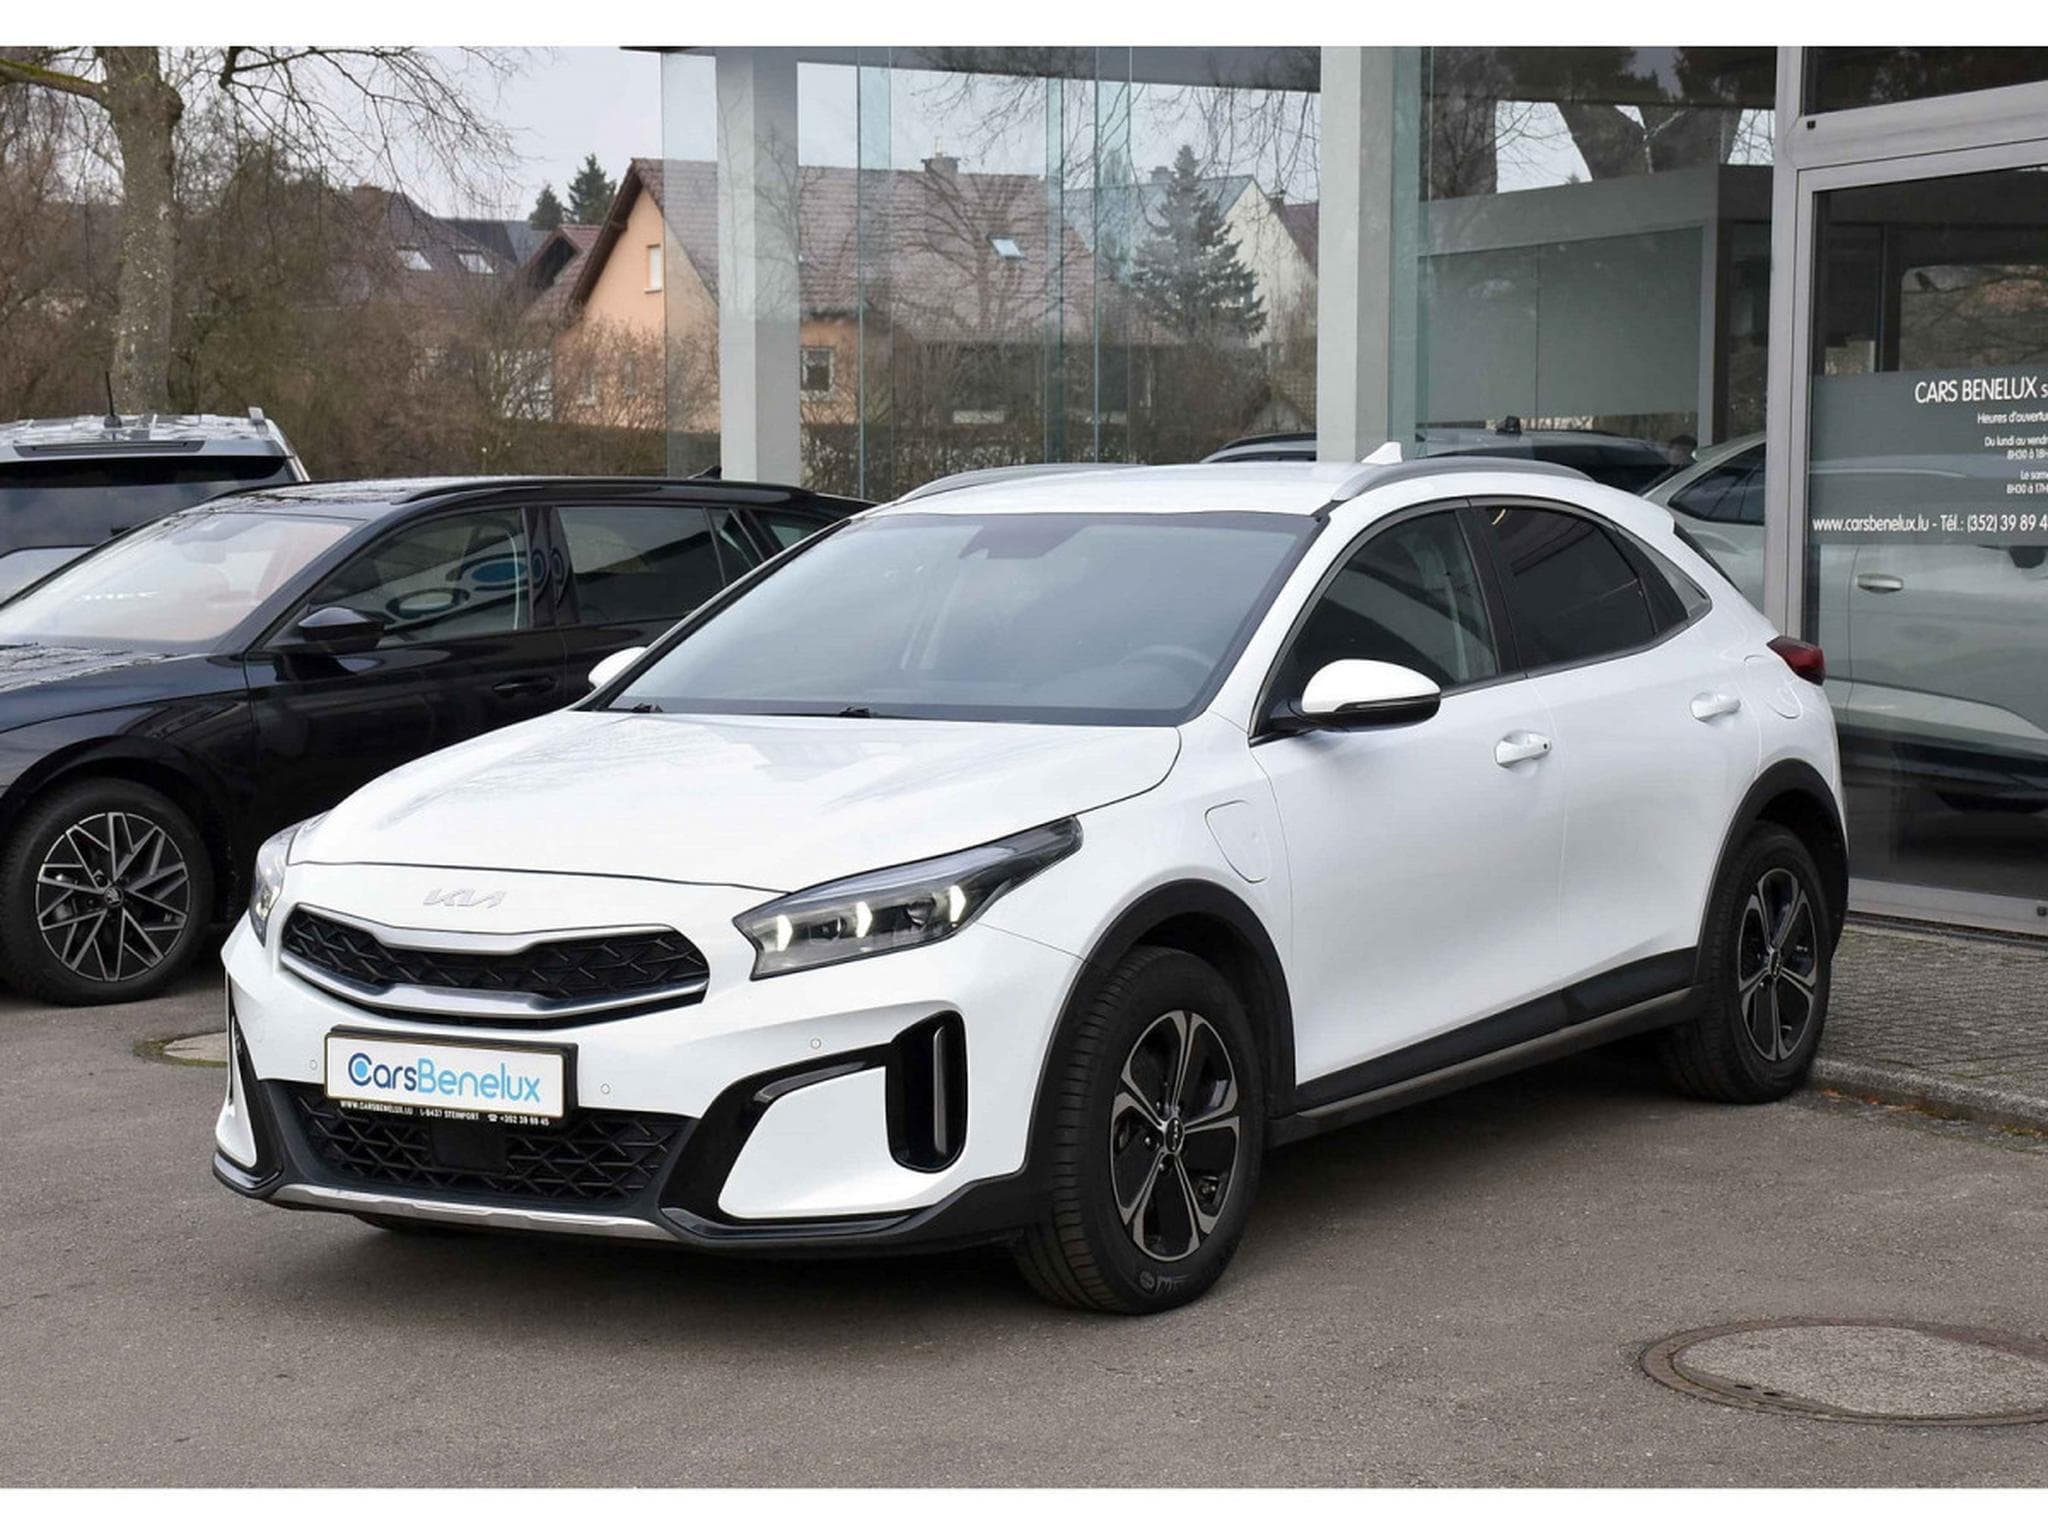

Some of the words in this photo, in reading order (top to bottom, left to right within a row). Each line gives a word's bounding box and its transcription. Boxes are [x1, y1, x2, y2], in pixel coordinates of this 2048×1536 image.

[1914, 380, 1958, 404] CARS
[1961, 376, 2038, 402] BENELUX
[1977, 412, 2007, 424] Heures
[1984, 436, 1996, 447] Du
[1812, 513, 1930, 532] www.carsbenelux.lu
[1940, 514, 1964, 532] Tél.:
[1967, 514, 1998, 533] (352)
[1999, 514, 2017, 532] 39
[2019, 514, 2037, 532] 89
[423, 887, 508, 910] KIA
[348, 1052, 541, 1104] CarsBenelux
